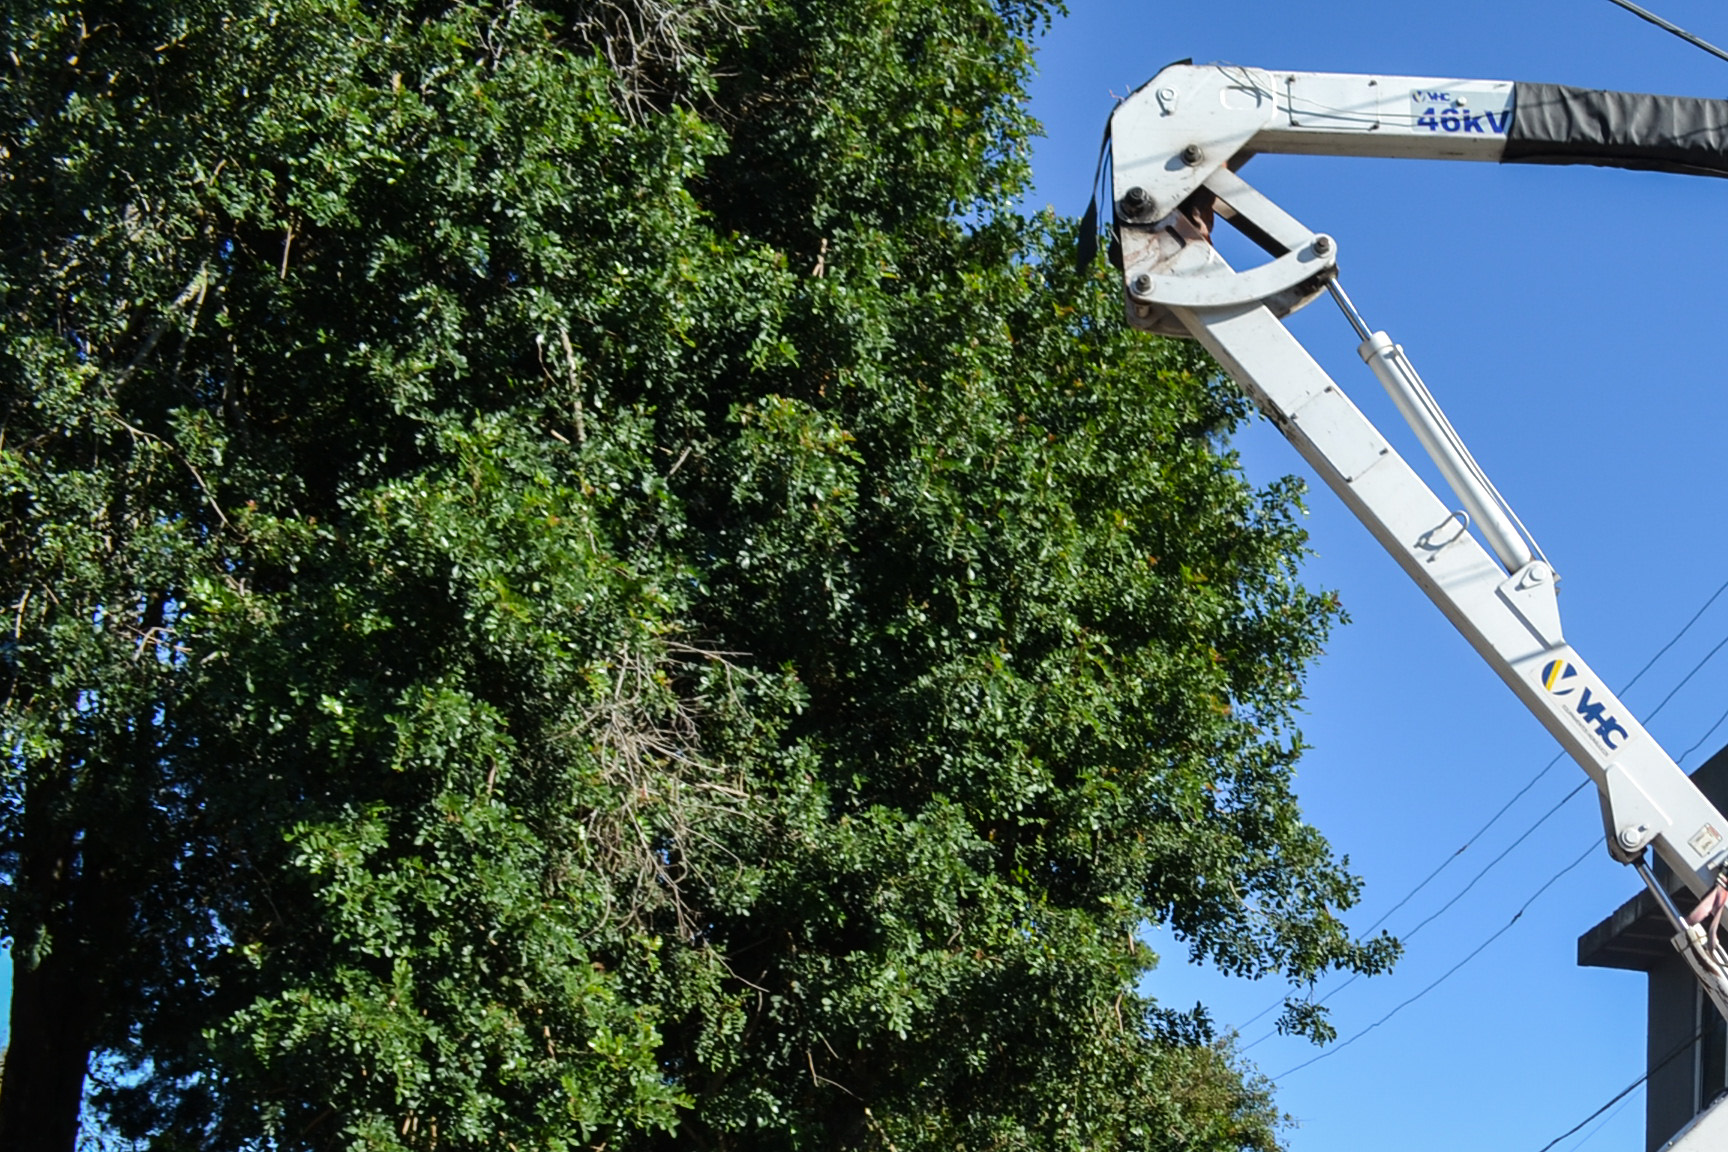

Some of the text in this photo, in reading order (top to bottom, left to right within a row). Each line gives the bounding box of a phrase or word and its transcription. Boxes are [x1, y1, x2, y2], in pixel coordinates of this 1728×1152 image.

[1427, 91, 1451, 102] VHC
[1417, 107, 1511, 134] 46kV
[1576, 686, 1629, 751] VHC
